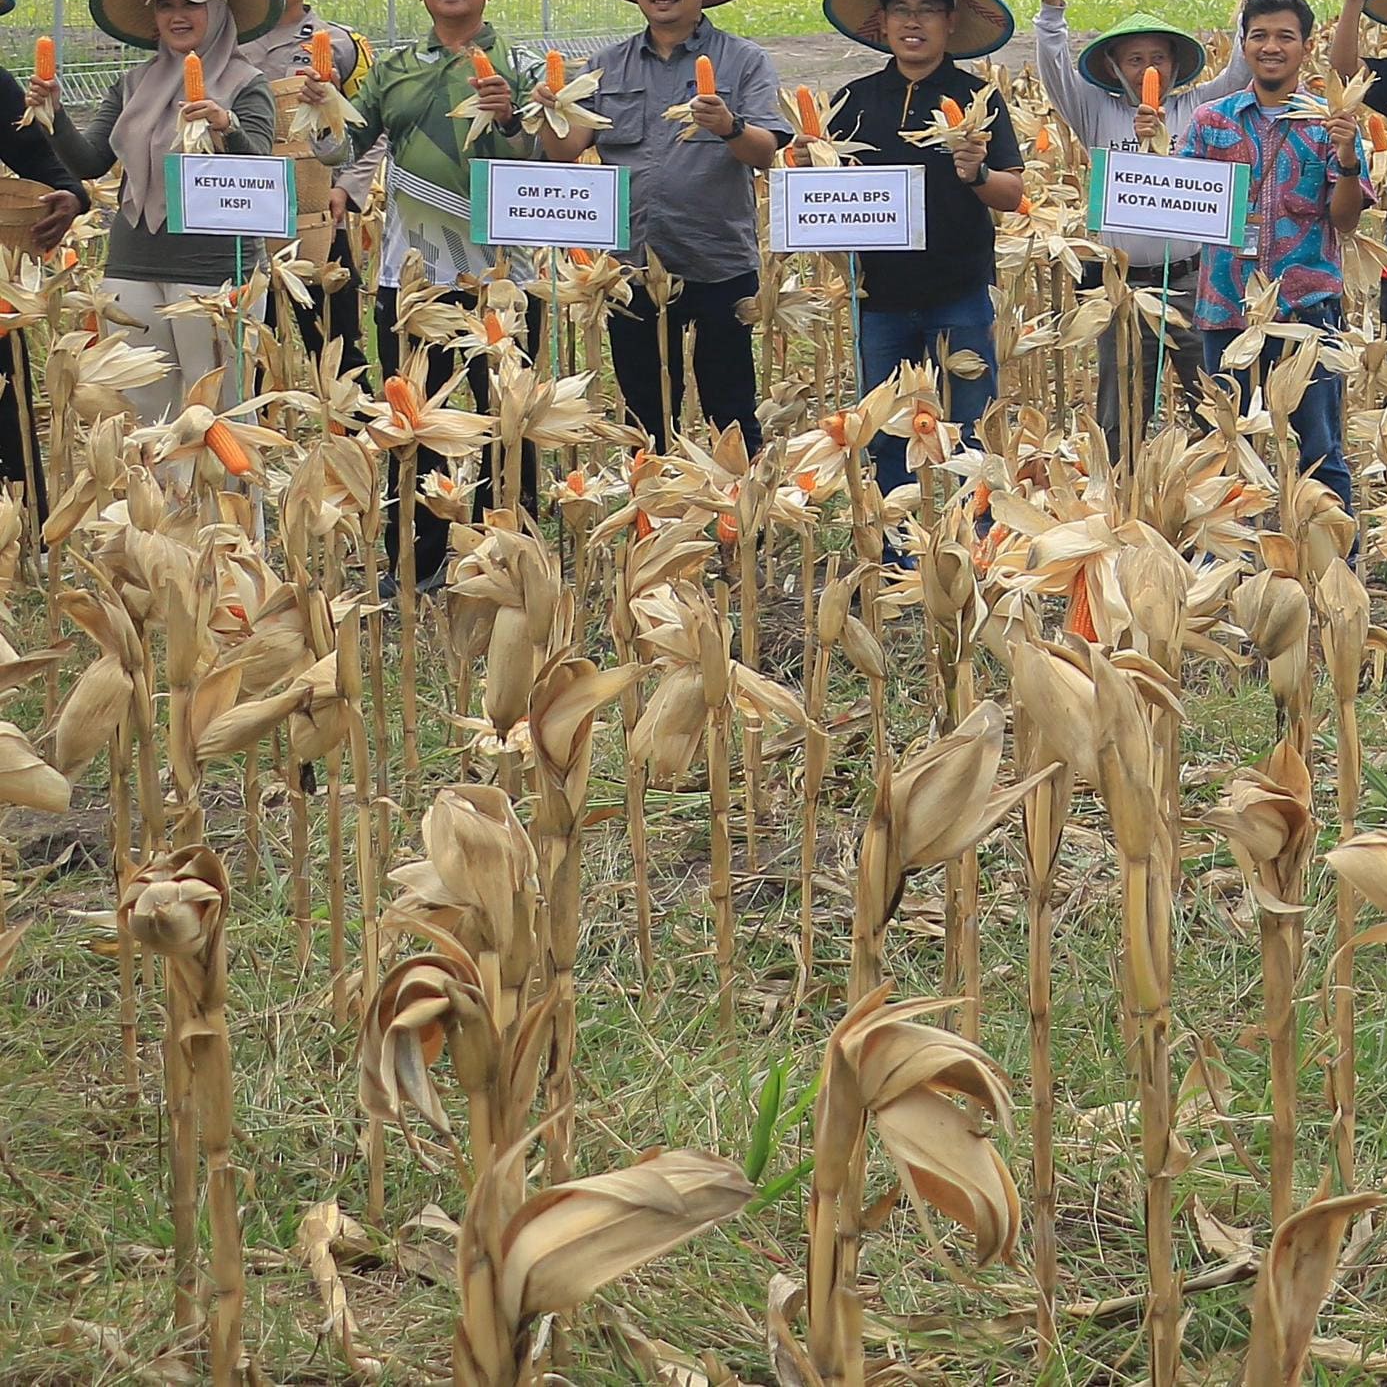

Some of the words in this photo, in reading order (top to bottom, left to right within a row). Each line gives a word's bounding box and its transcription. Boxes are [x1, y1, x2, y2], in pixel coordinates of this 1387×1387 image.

[195, 177, 235, 187] KETUA
[239, 179, 274, 189] UMUM
[1115, 172, 1170, 187] KEPALA
[1175, 179, 1223, 193] BULOG
[518, 187, 539, 197] GM
[544, 188, 565, 198] PT.
[570, 189, 589, 199] PG
[805, 192, 858, 202] KEPALA
[864, 192, 889, 202] BPS
[221, 198, 250, 209] IKSPI
[1118, 194, 1156, 207] KOTA
[1161, 198, 1217, 214] MADIUN
[509, 207, 597, 220] REJOAGUNG
[799, 214, 836, 224] KOTA
[841, 213, 896, 223] MADIUN
